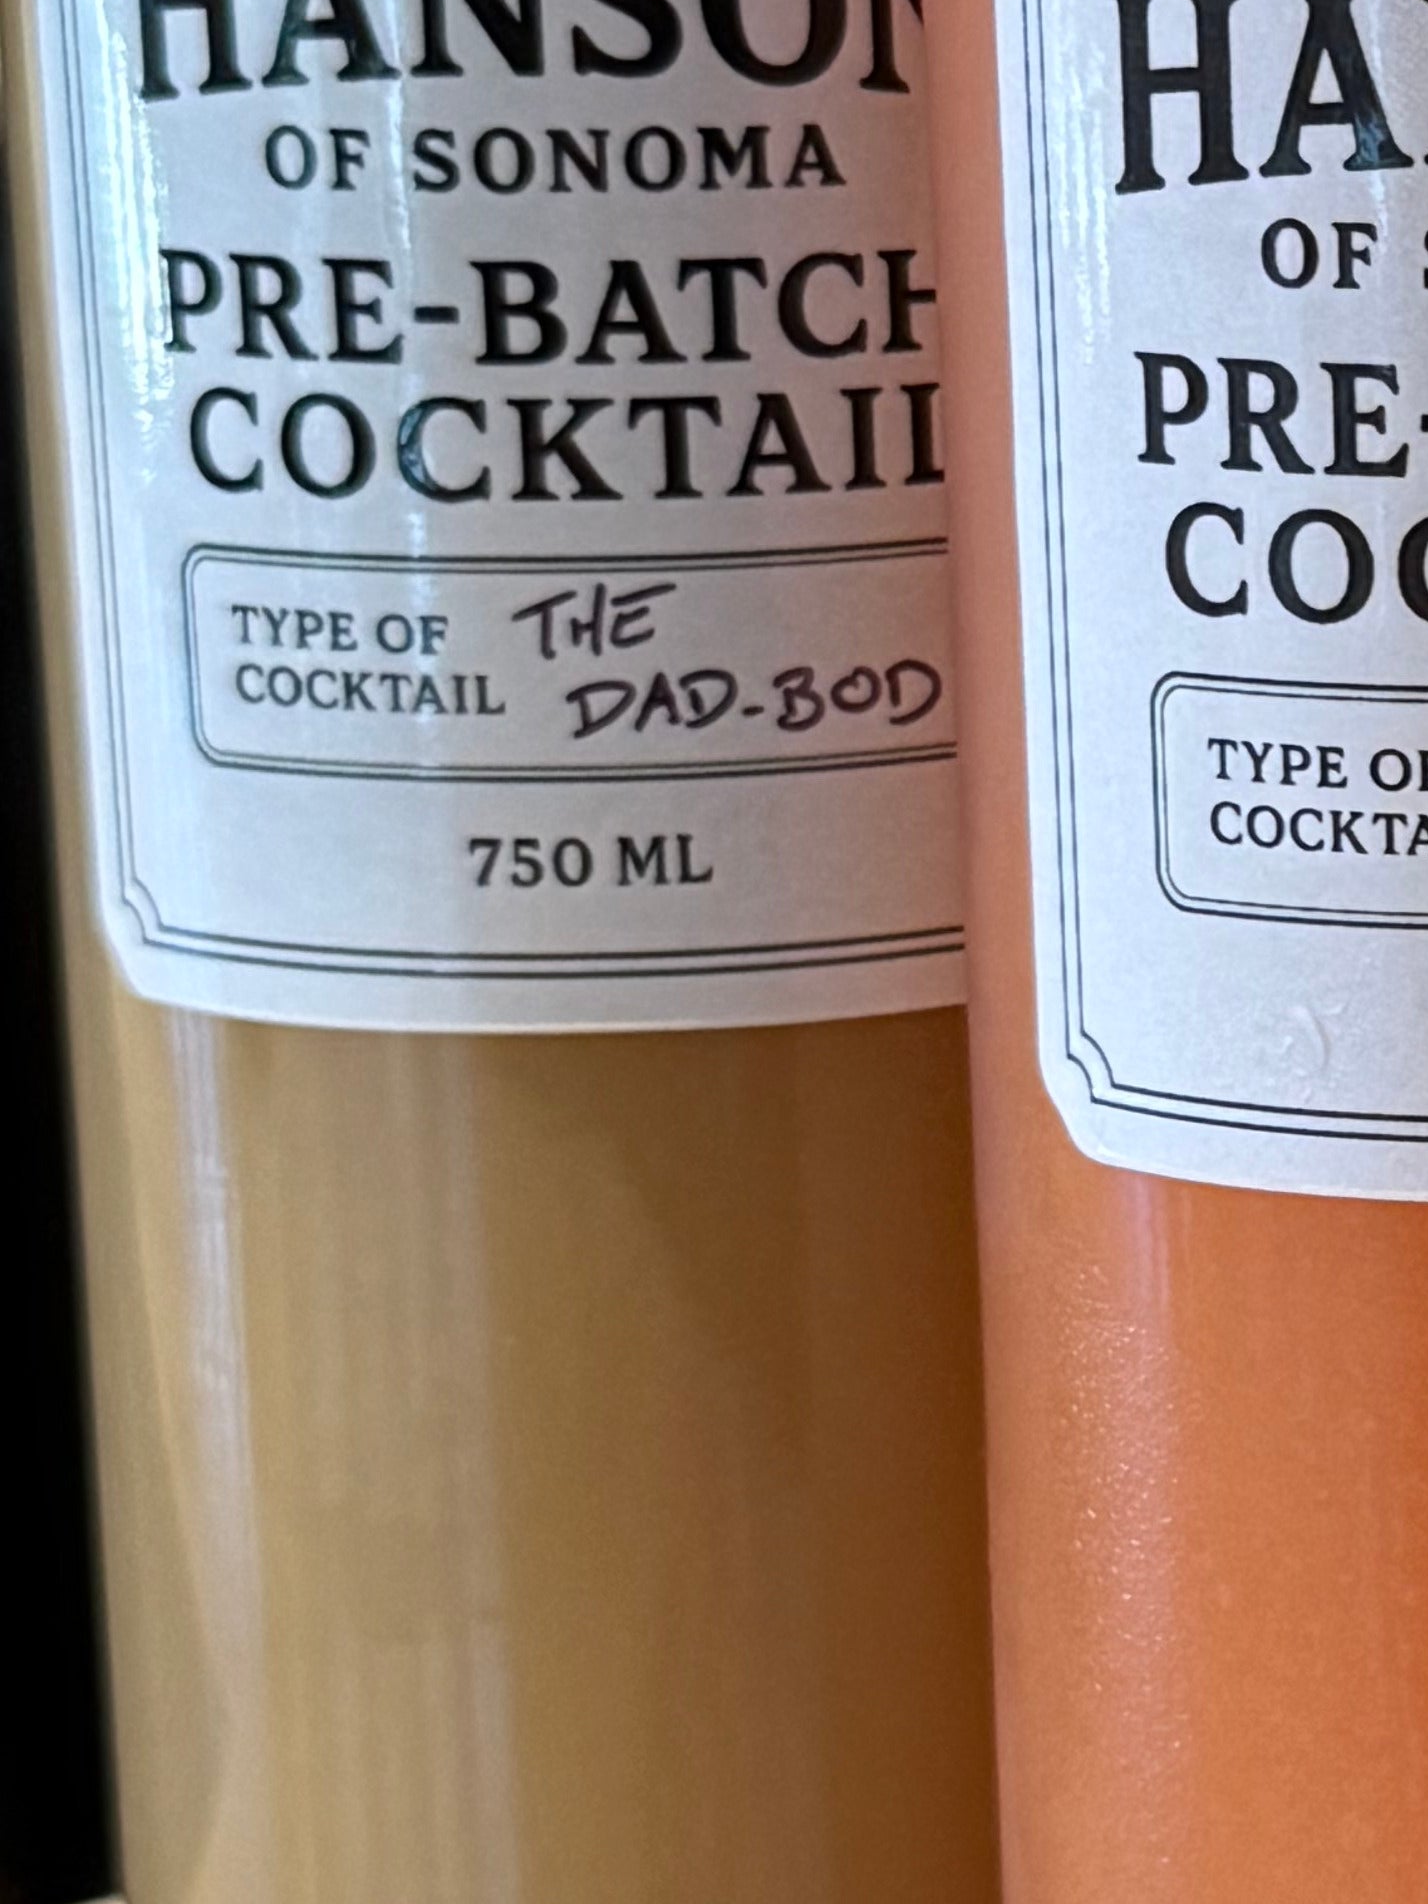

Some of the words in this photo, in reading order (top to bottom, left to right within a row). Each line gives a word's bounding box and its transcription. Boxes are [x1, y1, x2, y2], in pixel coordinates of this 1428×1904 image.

[264, 124, 370, 191] OF
[413, 123, 847, 194] SONOMA
[1260, 217, 1378, 290] OF
[230, 604, 358, 653] TYPE
[375, 613, 450, 655] OF
[511, 582, 677, 660] THE
[235, 663, 507, 716] COCKTAIL
[565, 658, 943, 739] DAD-BOD
[1207, 737, 1348, 790] TYPE
[468, 837, 594, 888] 750
[616, 833, 714, 887] ML
